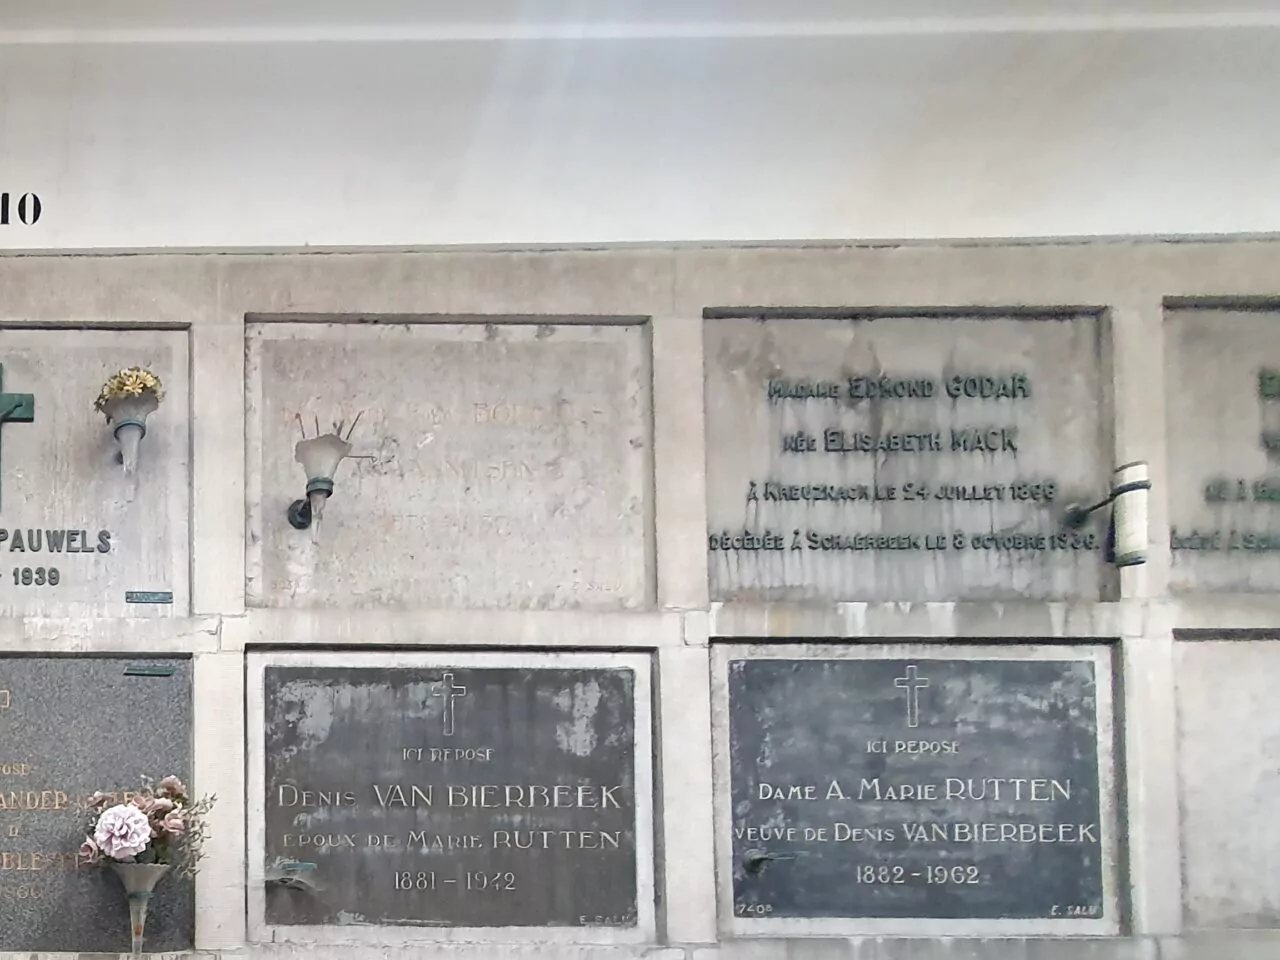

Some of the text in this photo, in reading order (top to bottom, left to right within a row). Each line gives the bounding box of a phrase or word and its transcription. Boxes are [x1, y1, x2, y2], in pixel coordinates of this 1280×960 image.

[848, 375, 935, 400] EDMOND
[824, 428, 942, 452] ELISABETH
[950, 427, 1018, 453] MACK
[874, 485, 897, 501] LE
[934, 485, 1005, 501] JUILLET
[806, 529, 919, 550] SCHAERBEEK
[925, 534, 947, 550] LE
[971, 534, 1046, 550] OCTOBRE
[13, 567, 60, 586] 1939
[402, 748, 494, 763] ICI REPOSE
[867, 740, 960, 754] ICI REPOSE
[278, 784, 623, 809] DENIS VAN BIERBEEK
[758, 778, 1072, 802] DAME A. MARIE RUTTEN
[366, 834, 396, 849] DE
[406, 831, 483, 849] MARIE
[493, 830, 622, 850] RUTTEN
[735, 827, 796, 842] VEUVE
[805, 827, 827, 842] DE
[834, 822, 895, 842] DENIS
[395, 872, 436, 890] 1881
[856, 865, 980, 884] 1882 1962
